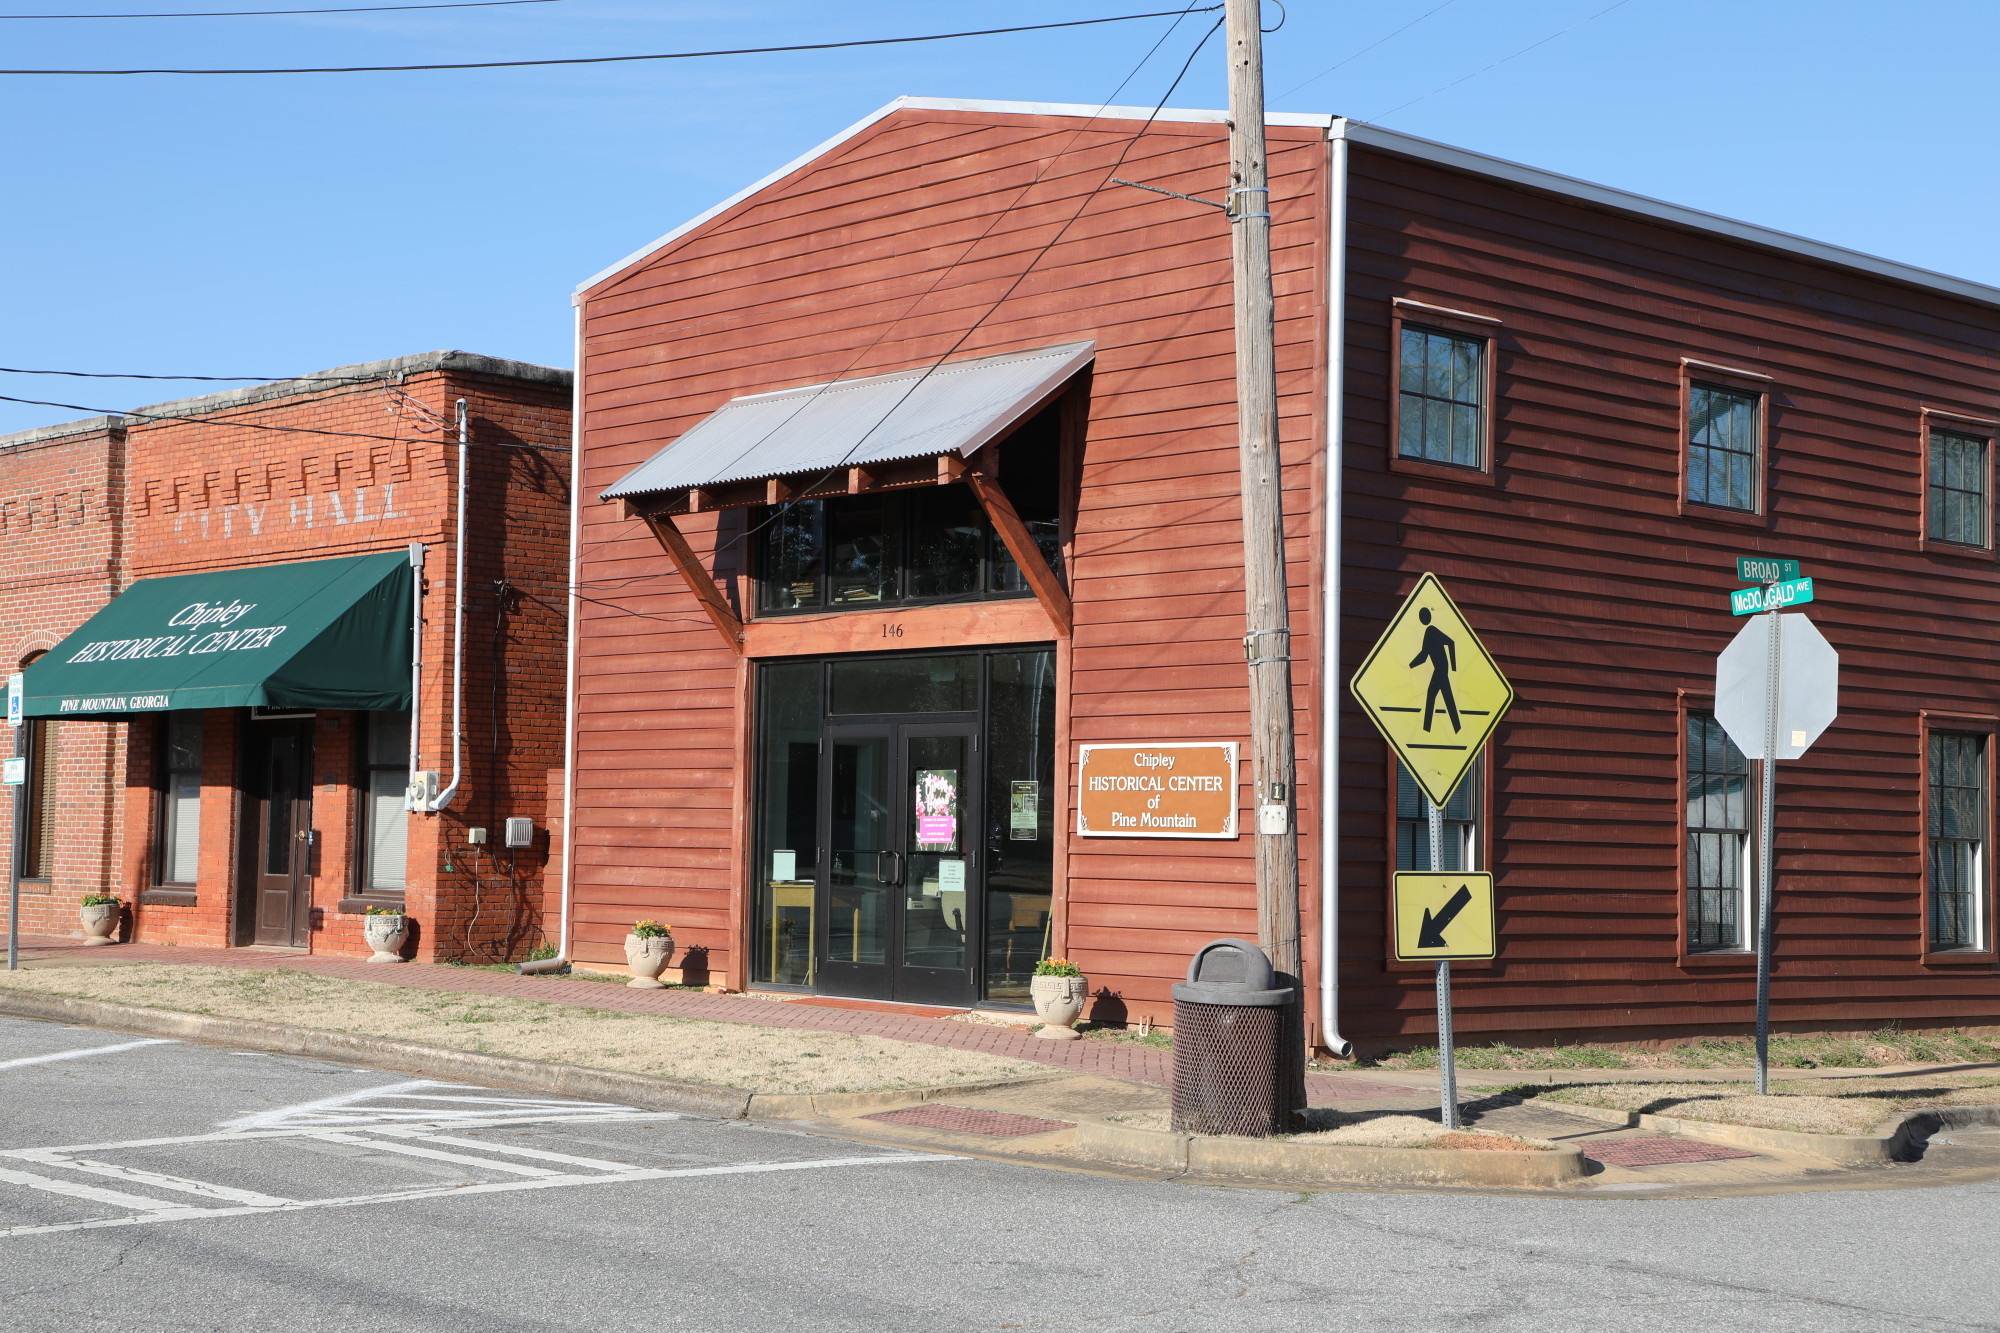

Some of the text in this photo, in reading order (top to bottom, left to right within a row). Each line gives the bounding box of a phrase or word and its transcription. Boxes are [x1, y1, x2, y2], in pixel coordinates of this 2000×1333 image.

[289, 483, 407, 530] HALL
[1743, 561, 1792, 579] BROAD ST
[1734, 581, 1810, 611] McDOUGALD AVE
[168, 599, 257, 631] Chipley
[881, 623, 904, 638] 146
[66, 625, 287, 664] HISTORICAL CENTER
[60, 695, 169, 712] PINE MOUNTAIN, GEORGIA
[1133, 752, 1176, 771] Chipley
[1088, 776, 1224, 792] HISTORICAL CENTER
[1273, 785, 1280, 799] 1
[1147, 794, 1161, 810] of
[1111, 812, 1197, 828] Pine Mountain
